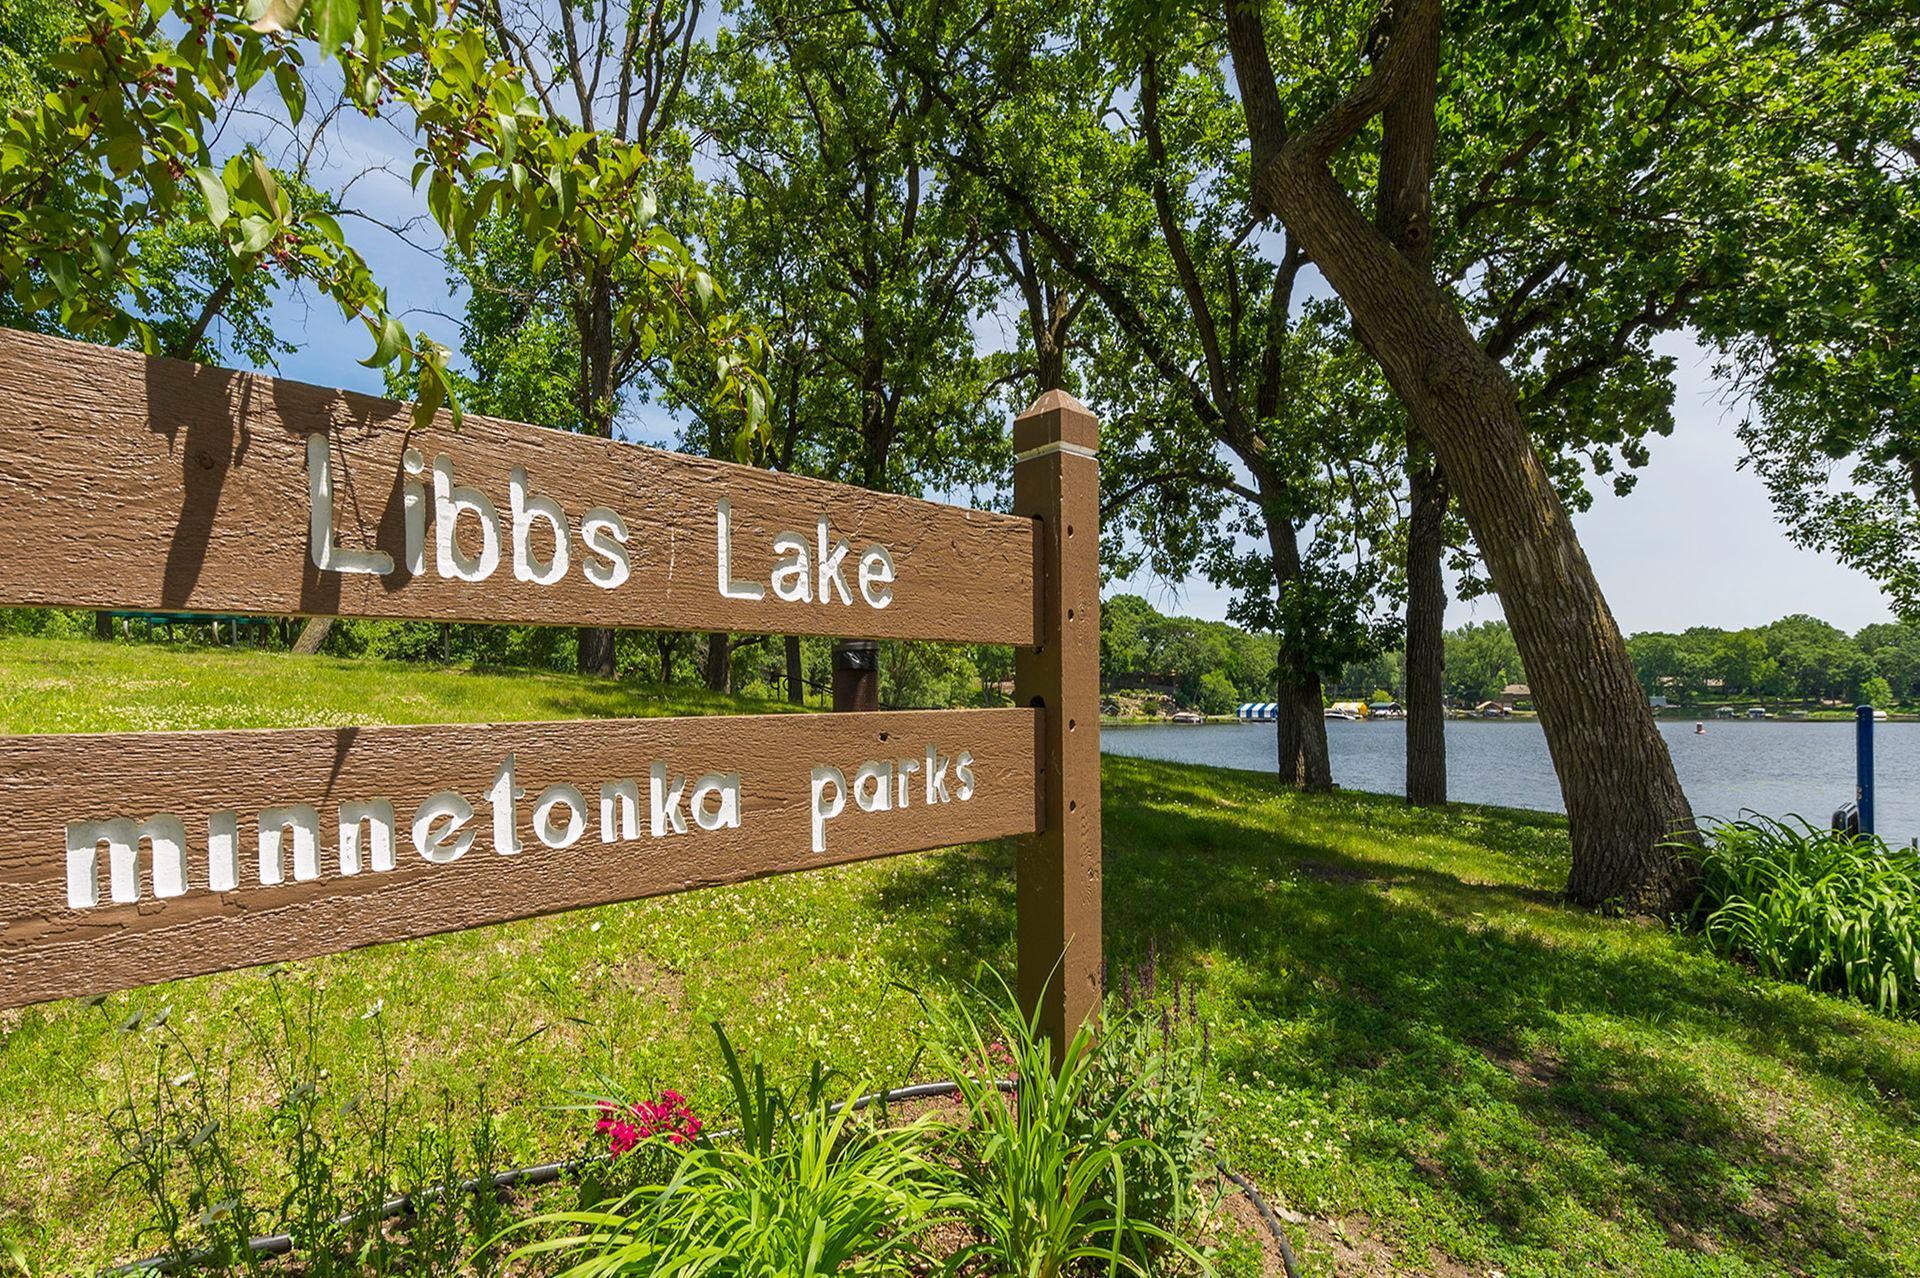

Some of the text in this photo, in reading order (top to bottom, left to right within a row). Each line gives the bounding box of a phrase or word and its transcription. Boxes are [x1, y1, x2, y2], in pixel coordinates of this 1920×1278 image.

[307, 433, 896, 609] Libbs Lake
[65, 743, 976, 910] minnetonka parks
